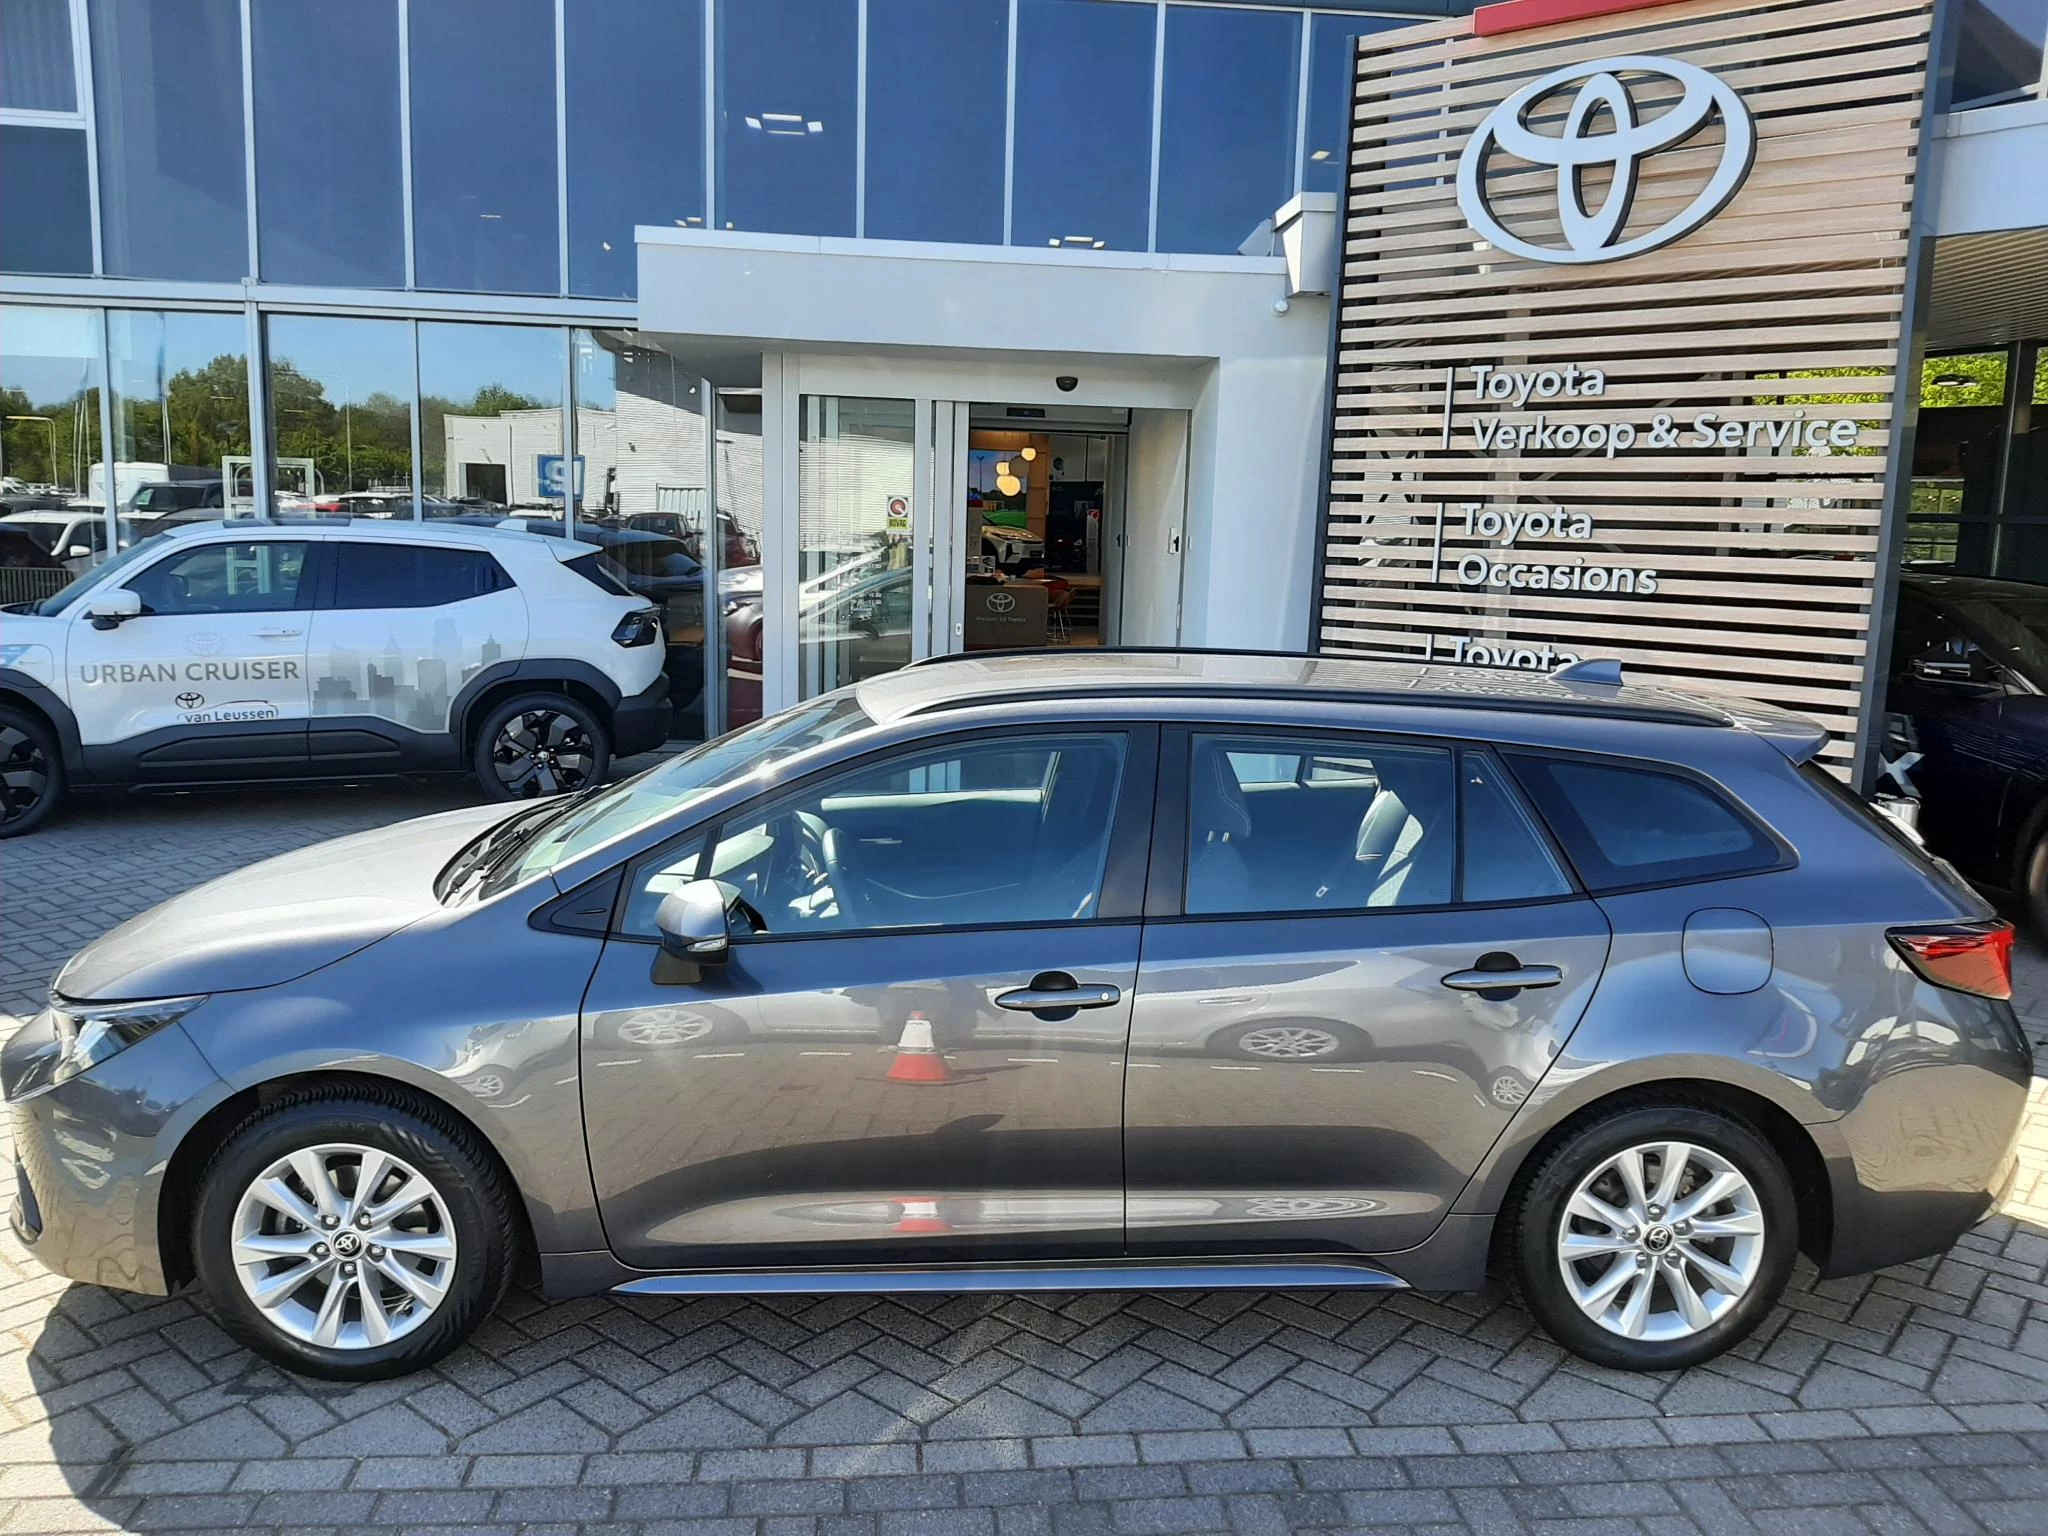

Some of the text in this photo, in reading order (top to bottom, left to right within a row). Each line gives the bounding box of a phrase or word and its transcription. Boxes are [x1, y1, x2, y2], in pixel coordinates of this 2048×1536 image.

[1470, 363, 1606, 408] Toyota
[1472, 409, 1859, 459] Verkoop & Service
[1459, 502, 1594, 546] Toyota
[1457, 554, 1659, 595] Occasions
[80, 661, 300, 684] URBAN CRUISER
[184, 708, 275, 723] van Leussen
